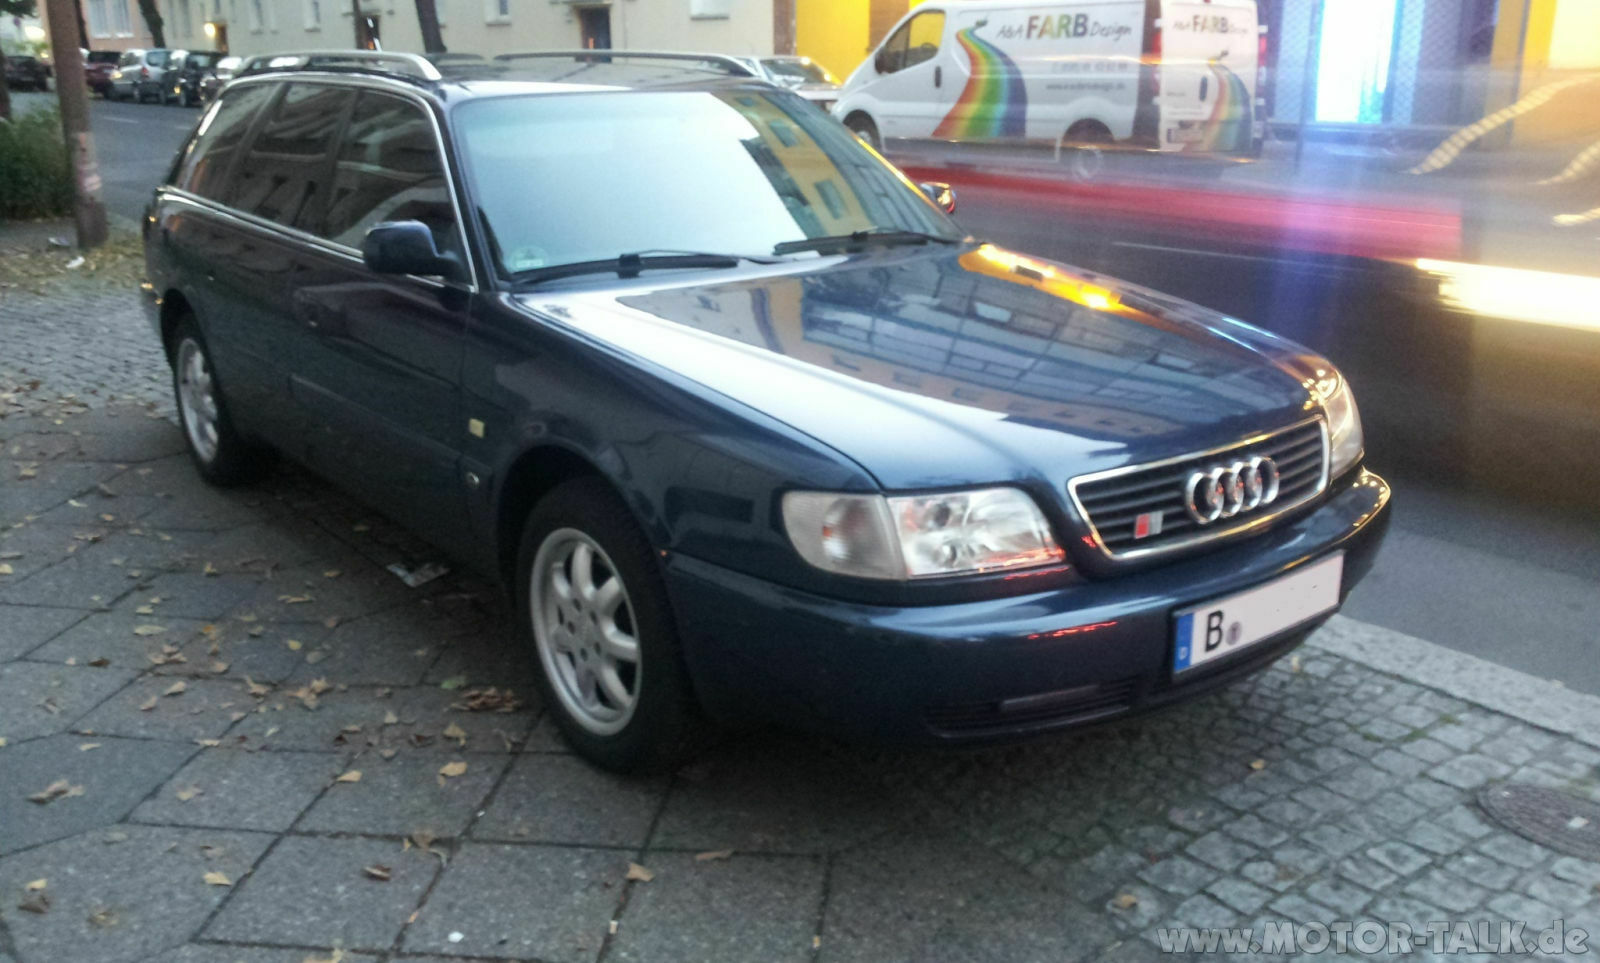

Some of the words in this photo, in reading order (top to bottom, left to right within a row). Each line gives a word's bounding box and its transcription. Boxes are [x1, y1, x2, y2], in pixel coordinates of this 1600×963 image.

[1026, 13, 1089, 39] FARB
[1090, 21, 1132, 42] Design
[1192, 14, 1229, 33] FARB
[1205, 610, 1224, 652] B
